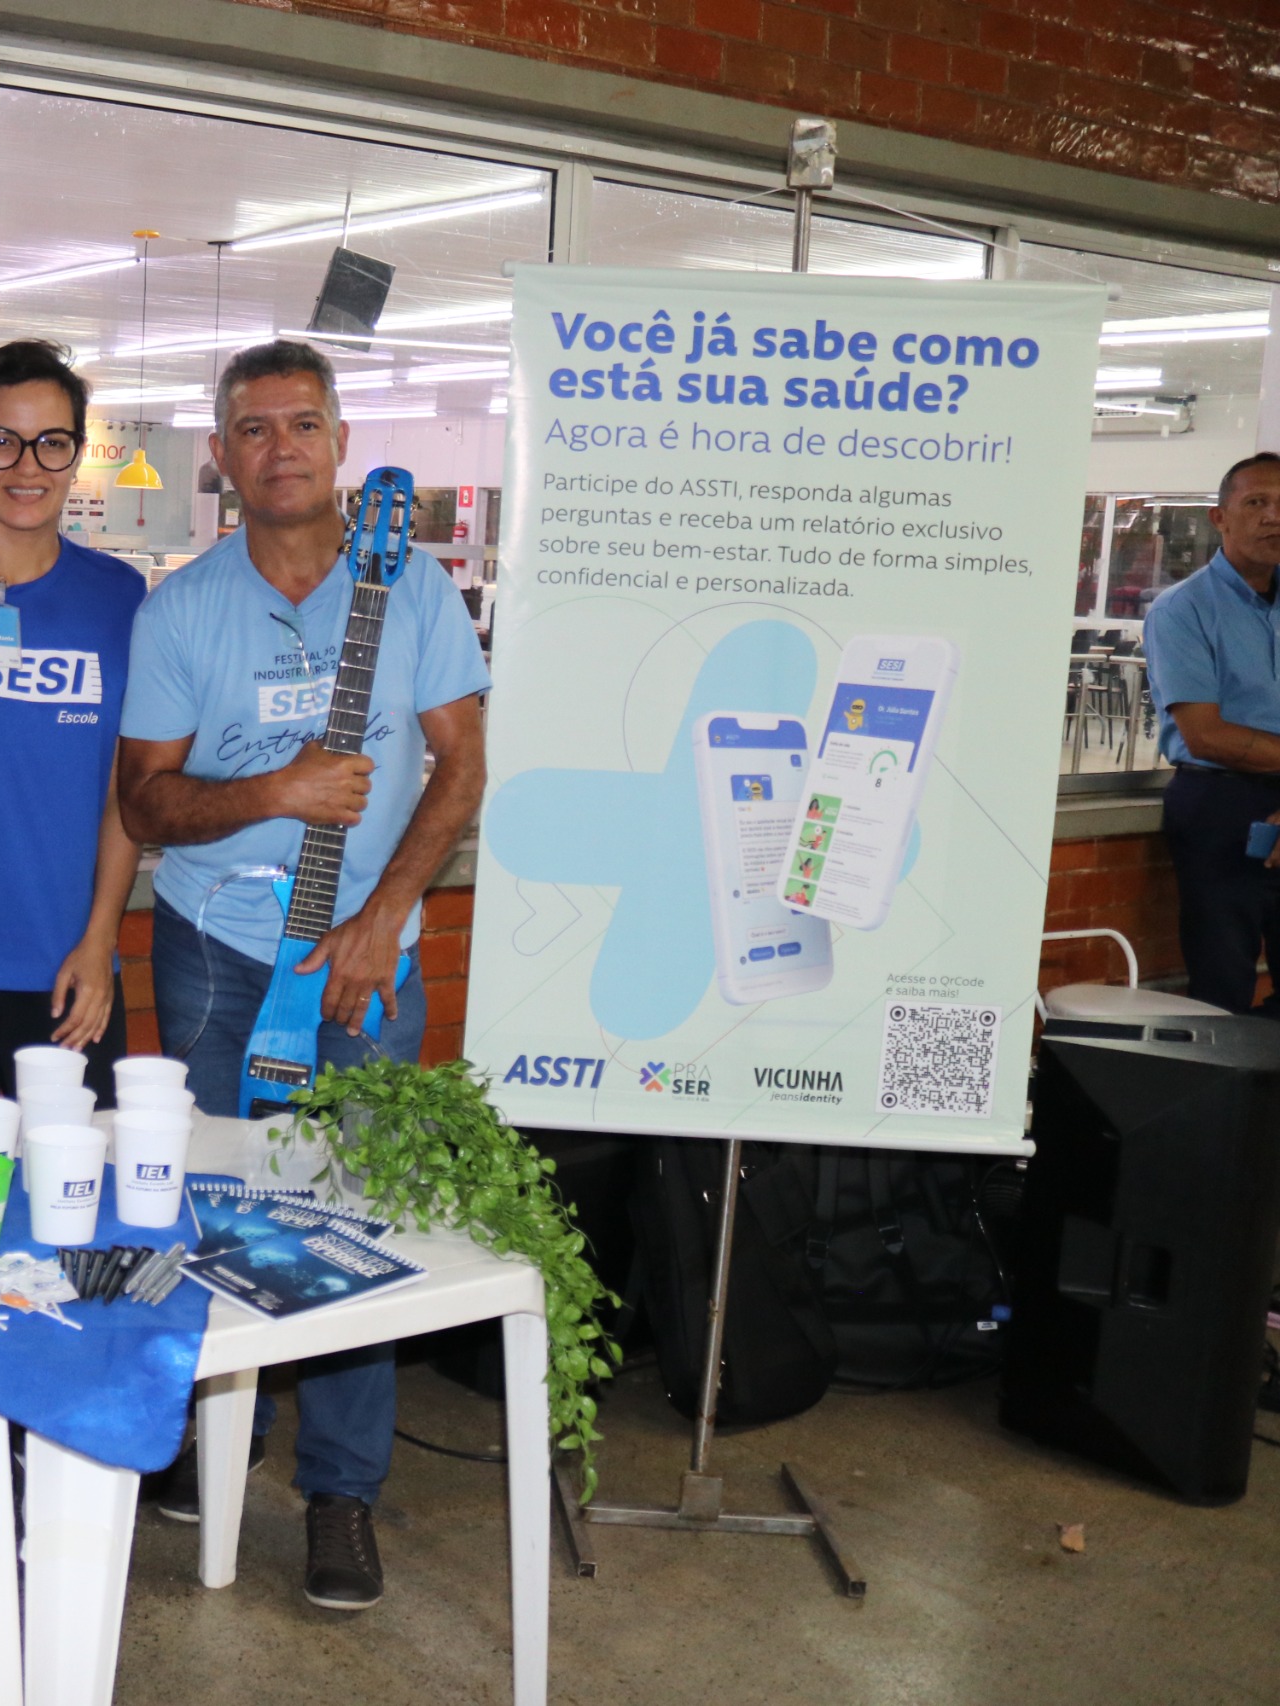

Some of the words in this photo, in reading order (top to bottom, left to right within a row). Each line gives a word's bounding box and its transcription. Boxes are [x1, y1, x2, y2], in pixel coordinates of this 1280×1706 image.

[551, 310, 675, 354] Você
[685, 311, 737, 363] já
[753, 320, 877, 362] sabe
[893, 333, 1039, 368] como
[549, 357, 662, 401] está
[678, 373, 768, 406] sua
[784, 366, 969, 414] saúde?
[545, 418, 647, 452] Agora
[660, 420, 678, 449] é
[692, 422, 771, 453] hora
[784, 426, 825, 455] de
[838, 430, 1011, 463] descobrir!
[544, 472, 637, 497] Participe
[645, 476, 673, 496] do
[680, 478, 742, 501] ASSTI,
[750, 483, 852, 504] responda
[860, 485, 951, 509] algumas
[542, 507, 651, 527] perguntas
[659, 512, 671, 527] e
[680, 510, 752, 530] receba
[761, 516, 794, 532] um
[803, 514, 894, 537] relatório
[902, 519, 1002, 541] exclusivo
[539, 535, 600, 555] sobre
[608, 541, 644, 557] seu
[653, 539, 771, 562] bem-estar.
[778, 545, 831, 565] Tudo
[839, 547, 865, 567] de
[873, 548, 937, 570] forma
[945, 552, 1032, 577] simples,
[538, 567, 668, 589] confidencial
[676, 575, 688, 590] e
[696, 576, 853, 597] personalizada.
[270, 681, 331, 718] SES
[57, 710, 99, 724] Escola
[886, 987, 893, 996] e
[895, 987, 926, 997] saiba
[929, 989, 960, 999] mais!
[887, 973, 926, 984] Acesse
[929, 976, 937, 985] o
[940, 975, 985, 988] QrCode
[503, 1054, 606, 1090] ASSTI
[671, 1079, 711, 1096] SER
[754, 1067, 844, 1092] VICUNHA
[67, 1182, 94, 1197] IEL
[139, 1165, 168, 1180] IEL
[301, 1237, 384, 1279] EXPERIENCE
